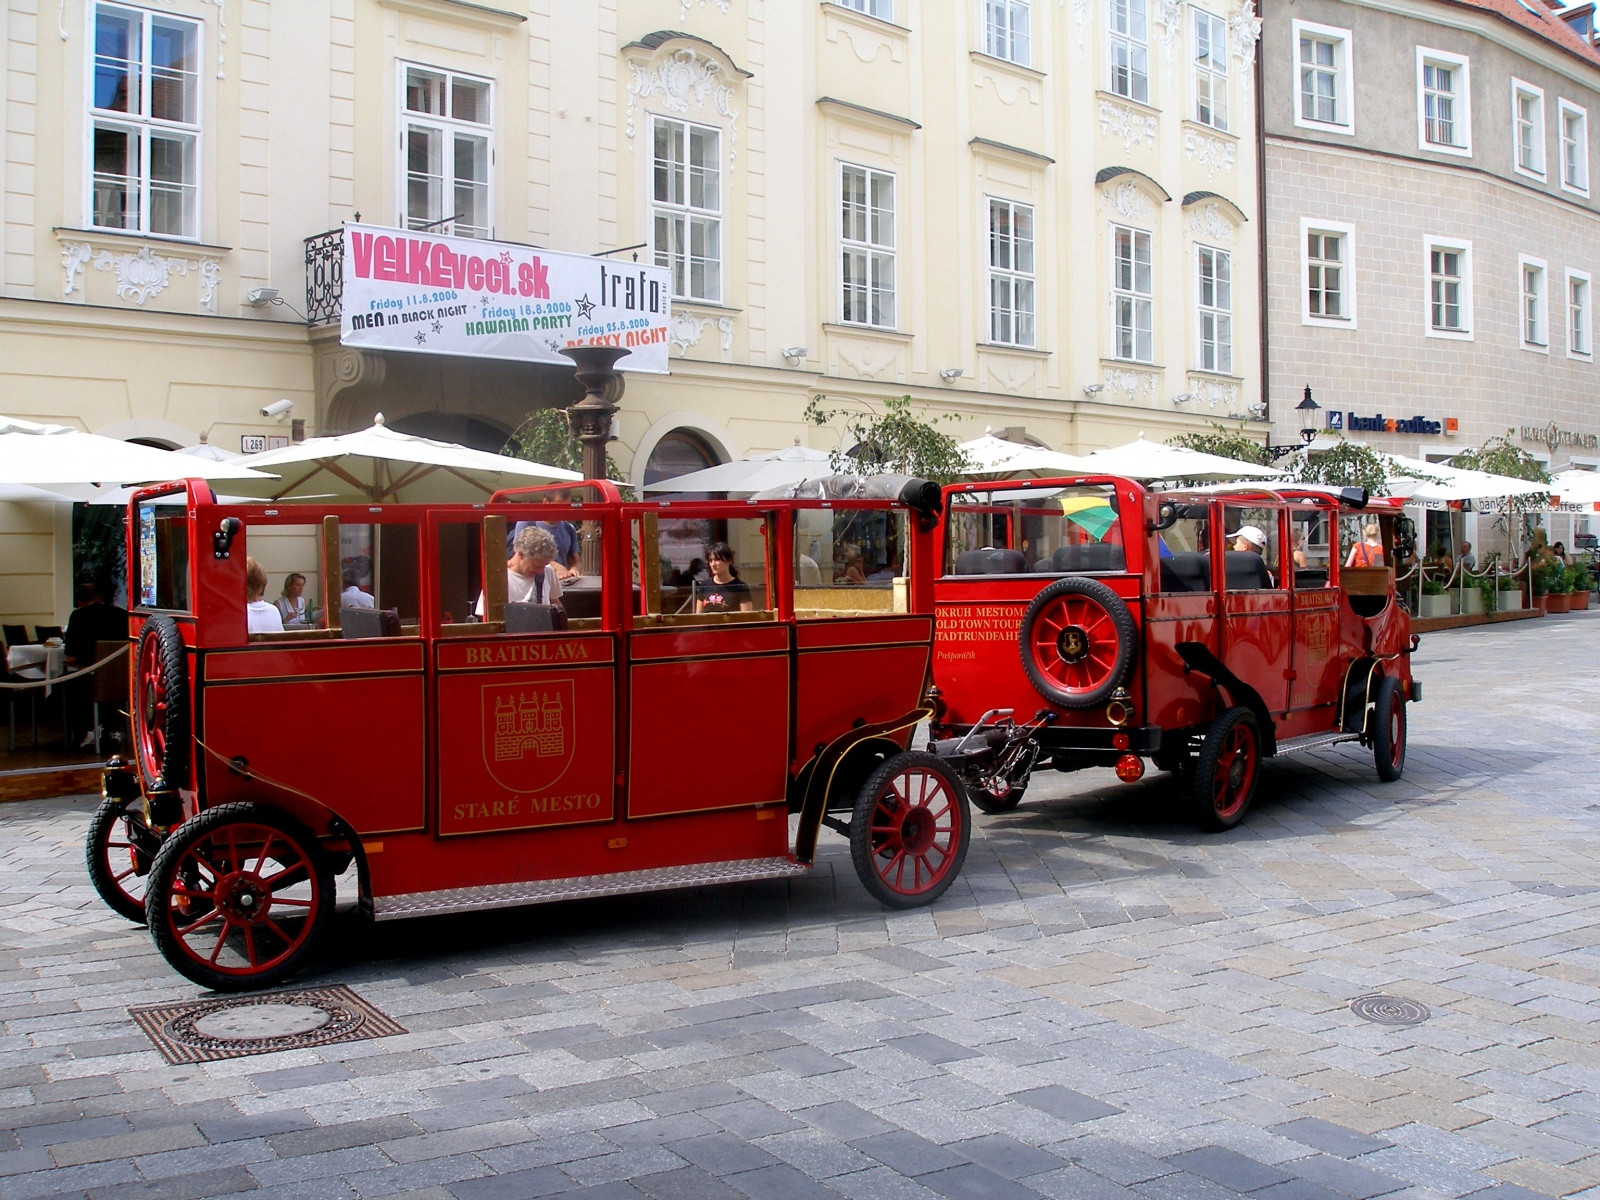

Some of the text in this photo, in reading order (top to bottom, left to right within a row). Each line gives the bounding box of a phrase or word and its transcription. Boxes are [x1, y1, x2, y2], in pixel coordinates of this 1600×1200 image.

[601, 265, 659, 313] trafo
[370, 290, 458, 311] Friday 11.8.2006
[481, 302, 572, 320] Friday 18.8.2006
[351, 305, 467, 330] MEN IN BLACK NIGHT
[465, 314, 573, 336] HAWAIAN PARTY
[577, 318, 650, 337] Friday 25.8.2006
[625, 326, 667, 348] NIGHT
[935, 607, 1024, 617] OKRUH MESTOM
[935, 619, 1022, 629] OLD TOWN TOUR
[465, 643, 589, 664] BRATISLAVA
[453, 793, 601, 820] STARÉ MESTO
